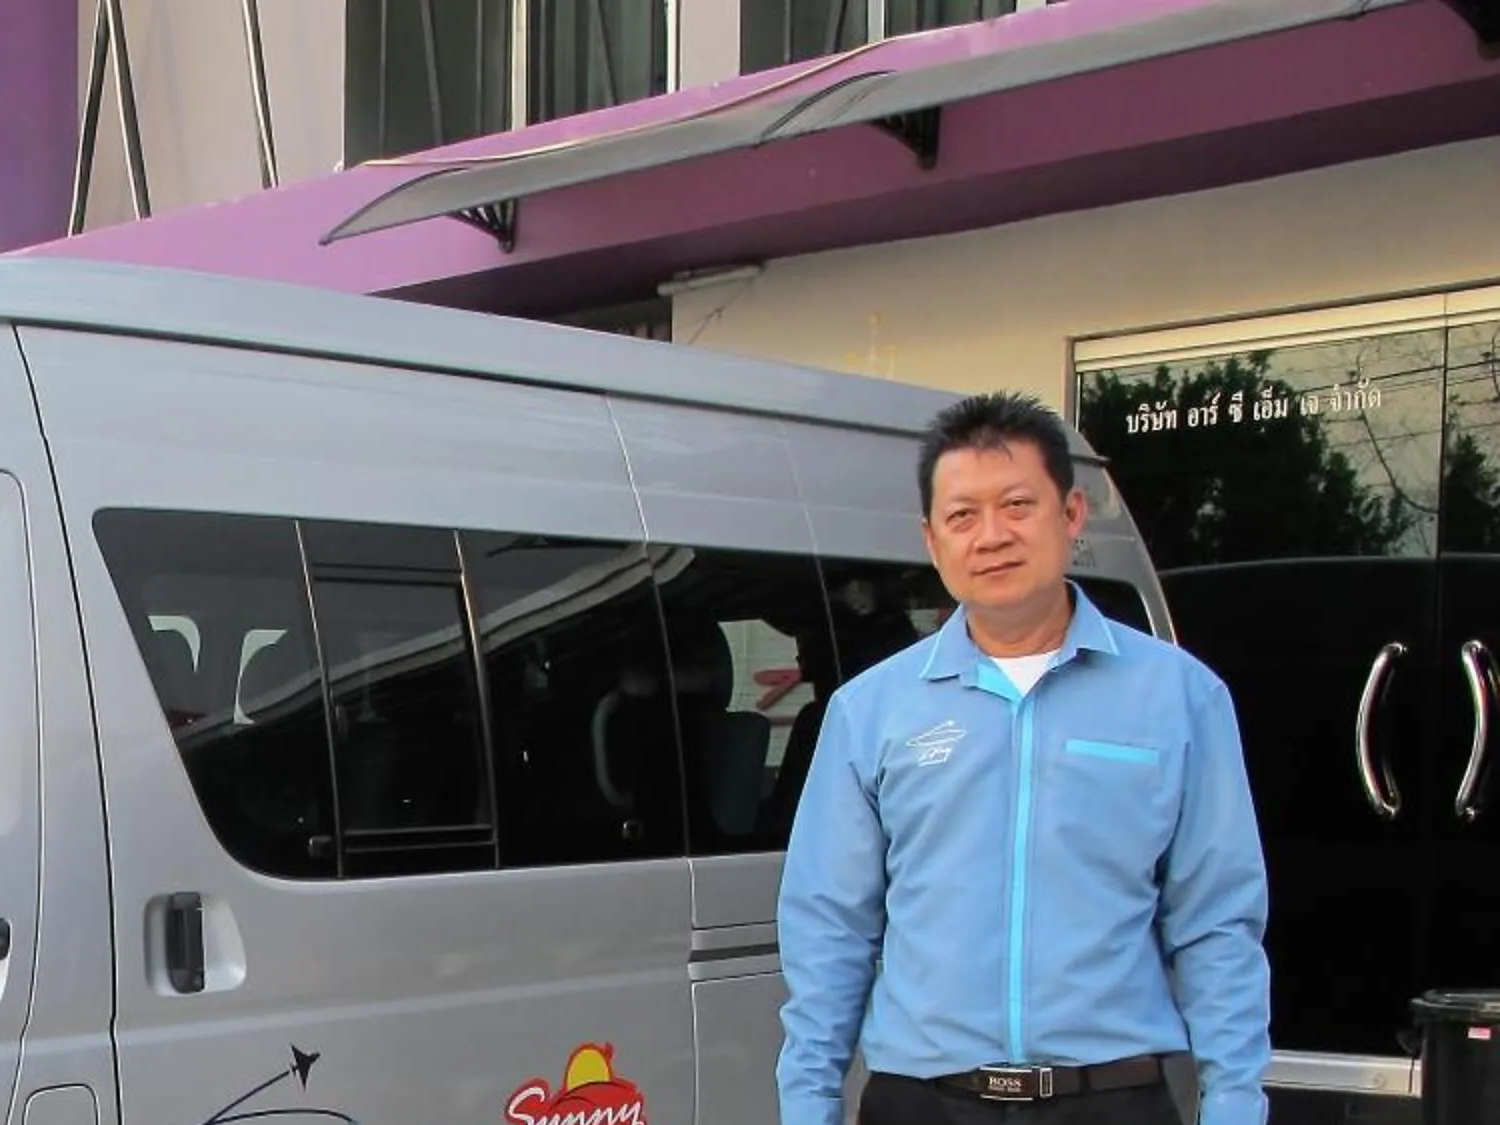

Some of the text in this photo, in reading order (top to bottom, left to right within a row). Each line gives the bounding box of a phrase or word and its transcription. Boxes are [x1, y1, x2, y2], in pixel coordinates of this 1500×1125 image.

[1126, 401, 1177, 433] บริษัท
[1187, 393, 1220, 427] อาร์
